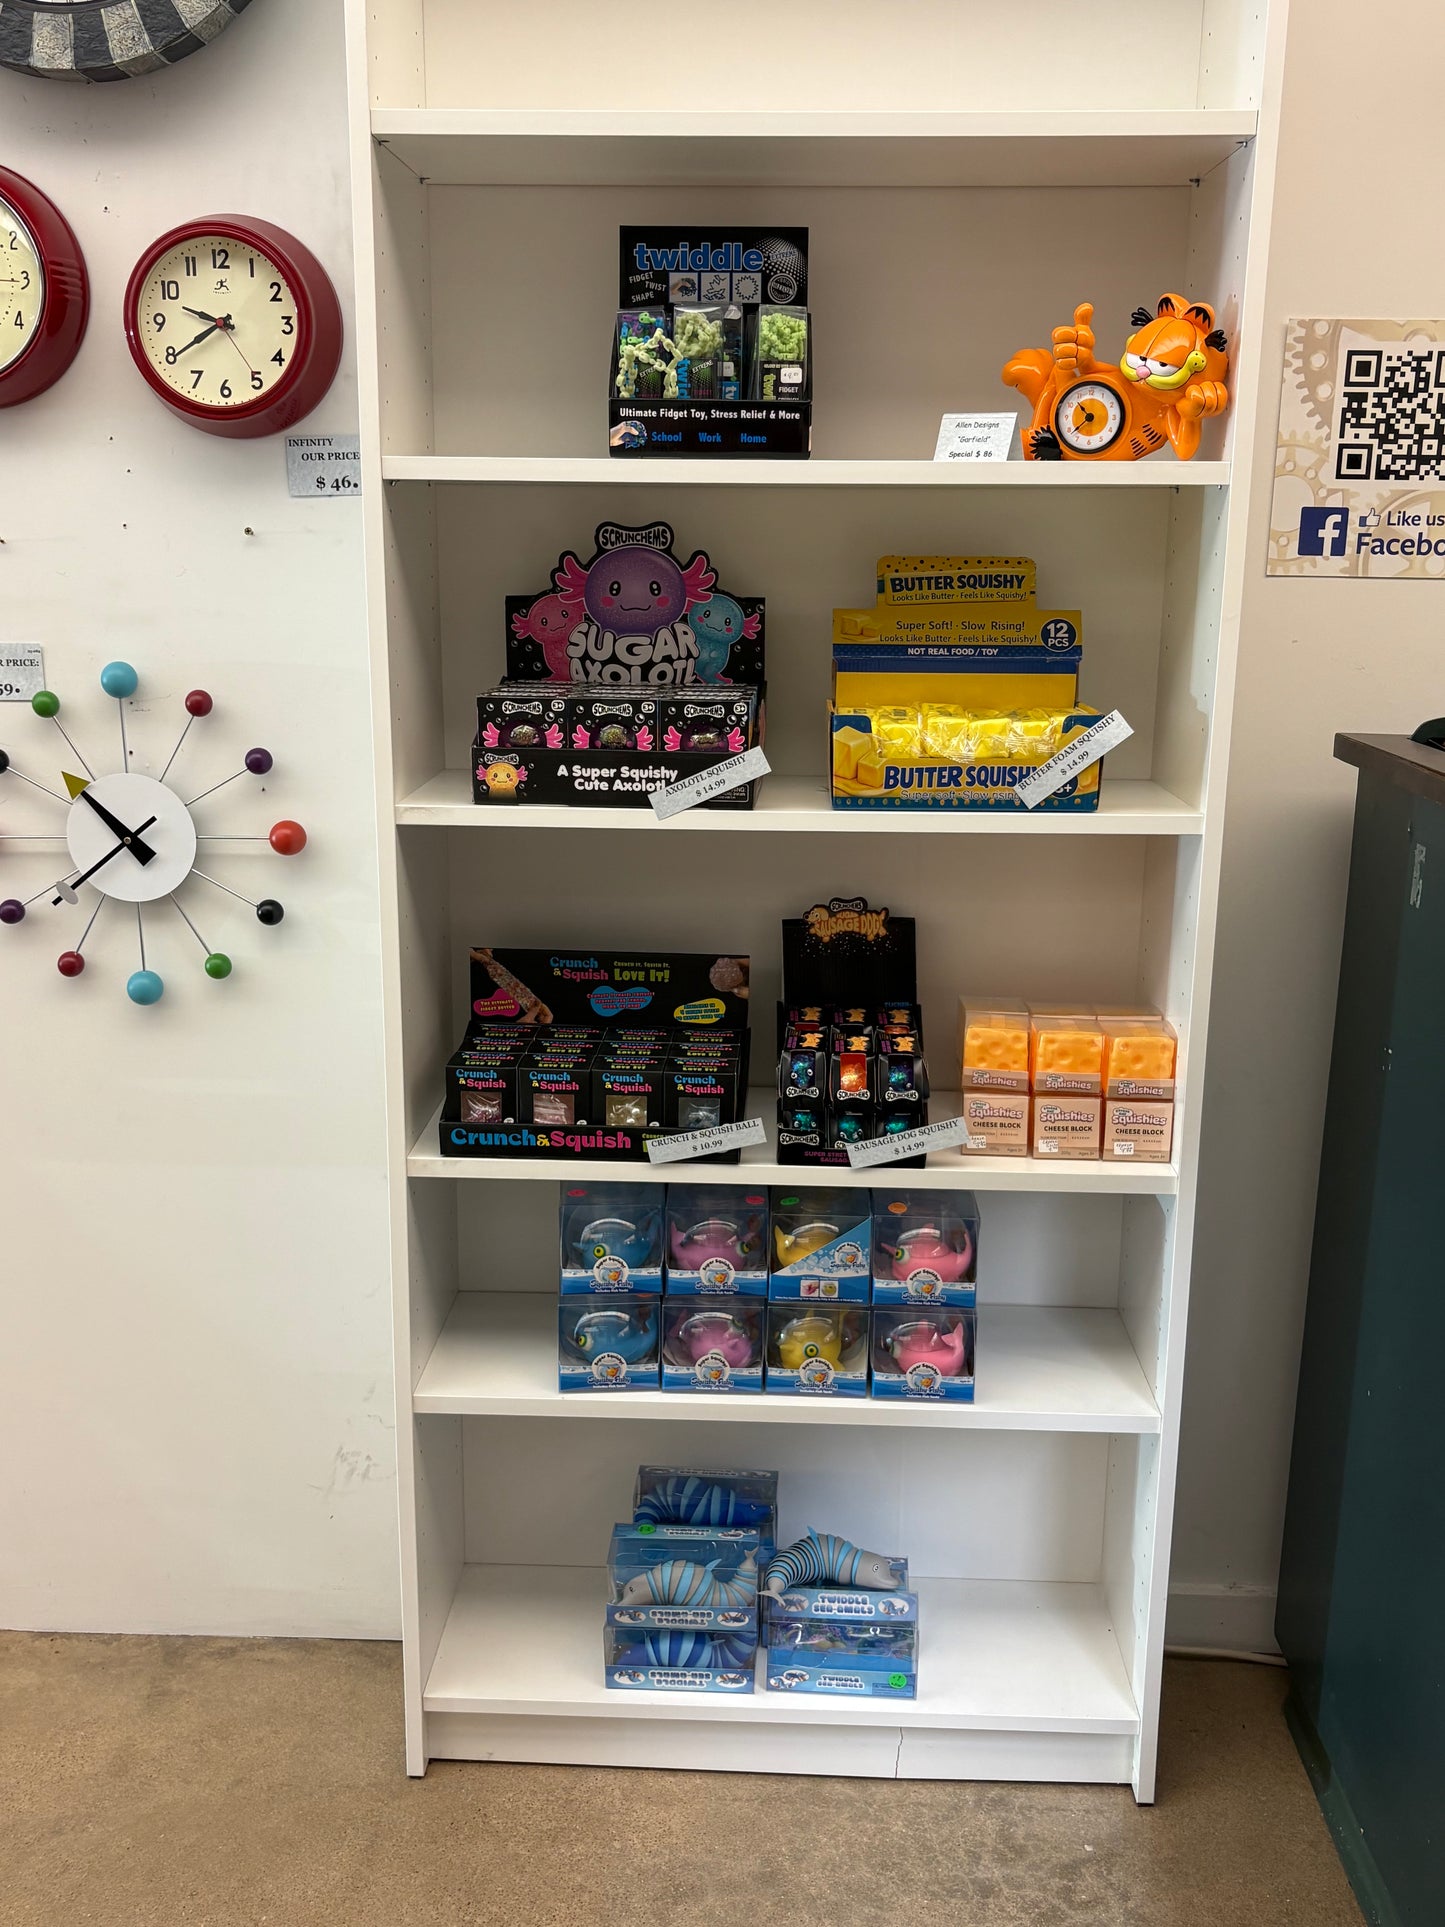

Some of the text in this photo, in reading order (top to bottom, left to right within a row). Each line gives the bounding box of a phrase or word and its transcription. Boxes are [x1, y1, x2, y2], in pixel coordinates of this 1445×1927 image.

[9, 231, 18, 250] 2
[211, 249, 230, 269] 12
[634, 243, 764, 271] twiddle
[185, 256, 197, 277] 11
[248, 258, 255, 278] 1
[20, 271, 30, 290] 3
[629, 272, 653, 283] FIDGET
[160, 280, 180, 301] 10
[645, 281, 667, 291] TWIST
[269, 282, 283, 303] 2
[632, 292, 654, 302] SHAPE
[14, 311, 24, 330] 4
[153, 313, 166, 333] 9
[281, 316, 294, 336] 3
[165, 346, 177, 365] 8
[270, 348, 285, 367] 4
[190, 370, 204, 389] 7
[251, 371, 264, 391] 5
[220, 380, 233, 399] 6
[620, 408, 800, 420] Ultimate Fidget Toy, Stress Relief & More
[974, 422, 999, 430] Designs
[288, 438, 333, 447] INFINITY
[651, 432, 682, 442] School
[699, 433, 722, 442] Work
[740, 434, 767, 443] Home
[301, 452, 325, 461] OUR
[948, 451, 973, 459] Special
[975, 450, 981, 458] $
[316, 475, 358, 491] $ 46.
[1387, 511, 1445, 526] Like us
[600, 528, 669, 549] SCRUNCHEMS
[1318, 514, 1342, 556] f
[890, 574, 1026, 593] BUTTER SQUISHY
[892, 591, 1027, 602] Looks Like Butter Feels Like Squishy!
[896, 620, 1025, 632] Super Soft! Slow Rising!
[1047, 622, 1069, 638] 12
[566, 622, 700, 666] SUGAR
[880, 634, 1037, 644] Looks Like Butter Feels Like Squishy!
[1048, 638, 1069, 647] PCS
[951, 648, 975, 656] FOOD
[982, 648, 999, 656] TOY
[6, 658, 39, 667] PRICE:
[502, 702, 542, 714] SCRUNCHEMS
[552, 702, 563, 710] 3+
[593, 703, 632, 716] SCRUNCHEMS
[685, 705, 724, 718] SCRUNCHEMS
[1018, 714, 1115, 790] BUTTER FOAM SQUISHY
[1067, 750, 1089, 770] 14.99
[557, 764, 678, 782] A Super Squishy
[665, 774, 706, 797] AXOLOTL
[706, 755, 746, 778] SQUISHY
[884, 765, 1039, 789] BUTTER SQUISH
[574, 779, 666, 791] Cute Axolotl
[695, 789, 702, 797] $
[703, 778, 726, 794] 14.99
[901, 790, 931, 802] Super
[935, 790, 956, 800] soft
[962, 790, 989, 800] Slow
[549, 956, 599, 968] Crunch
[553, 968, 609, 982] & Squish
[456, 1069, 497, 1079] Crunch
[529, 1071, 570, 1081] Crunch
[602, 1073, 643, 1083] Crunch
[674, 1074, 715, 1084] Crunch
[467, 1079, 506, 1090] Squish
[540, 1081, 579, 1091] Squish
[613, 1082, 652, 1093] Squish
[972, 1077, 1017, 1087] squishies
[1046, 1080, 1092, 1090] squishies
[685, 1084, 724, 1094] Squish
[1118, 1086, 1163, 1096] squishies
[970, 1108, 1023, 1119] squishies
[1040, 1111, 1094, 1123] squishies
[1112, 1114, 1166, 1126] squishies
[651, 1135, 689, 1147] CRUNCH
[699, 1126, 734, 1138] SQUISH
[736, 1120, 759, 1131] BALL
[854, 1137, 896, 1151] SAUSAGE
[897, 1129, 917, 1142] DOG
[917, 1120, 959, 1136] SQUISHY
[700, 1139, 723, 1150] 10.99
[893, 1141, 925, 1155] $ 14.99
[819, 1594, 868, 1605] TWIDDLE
